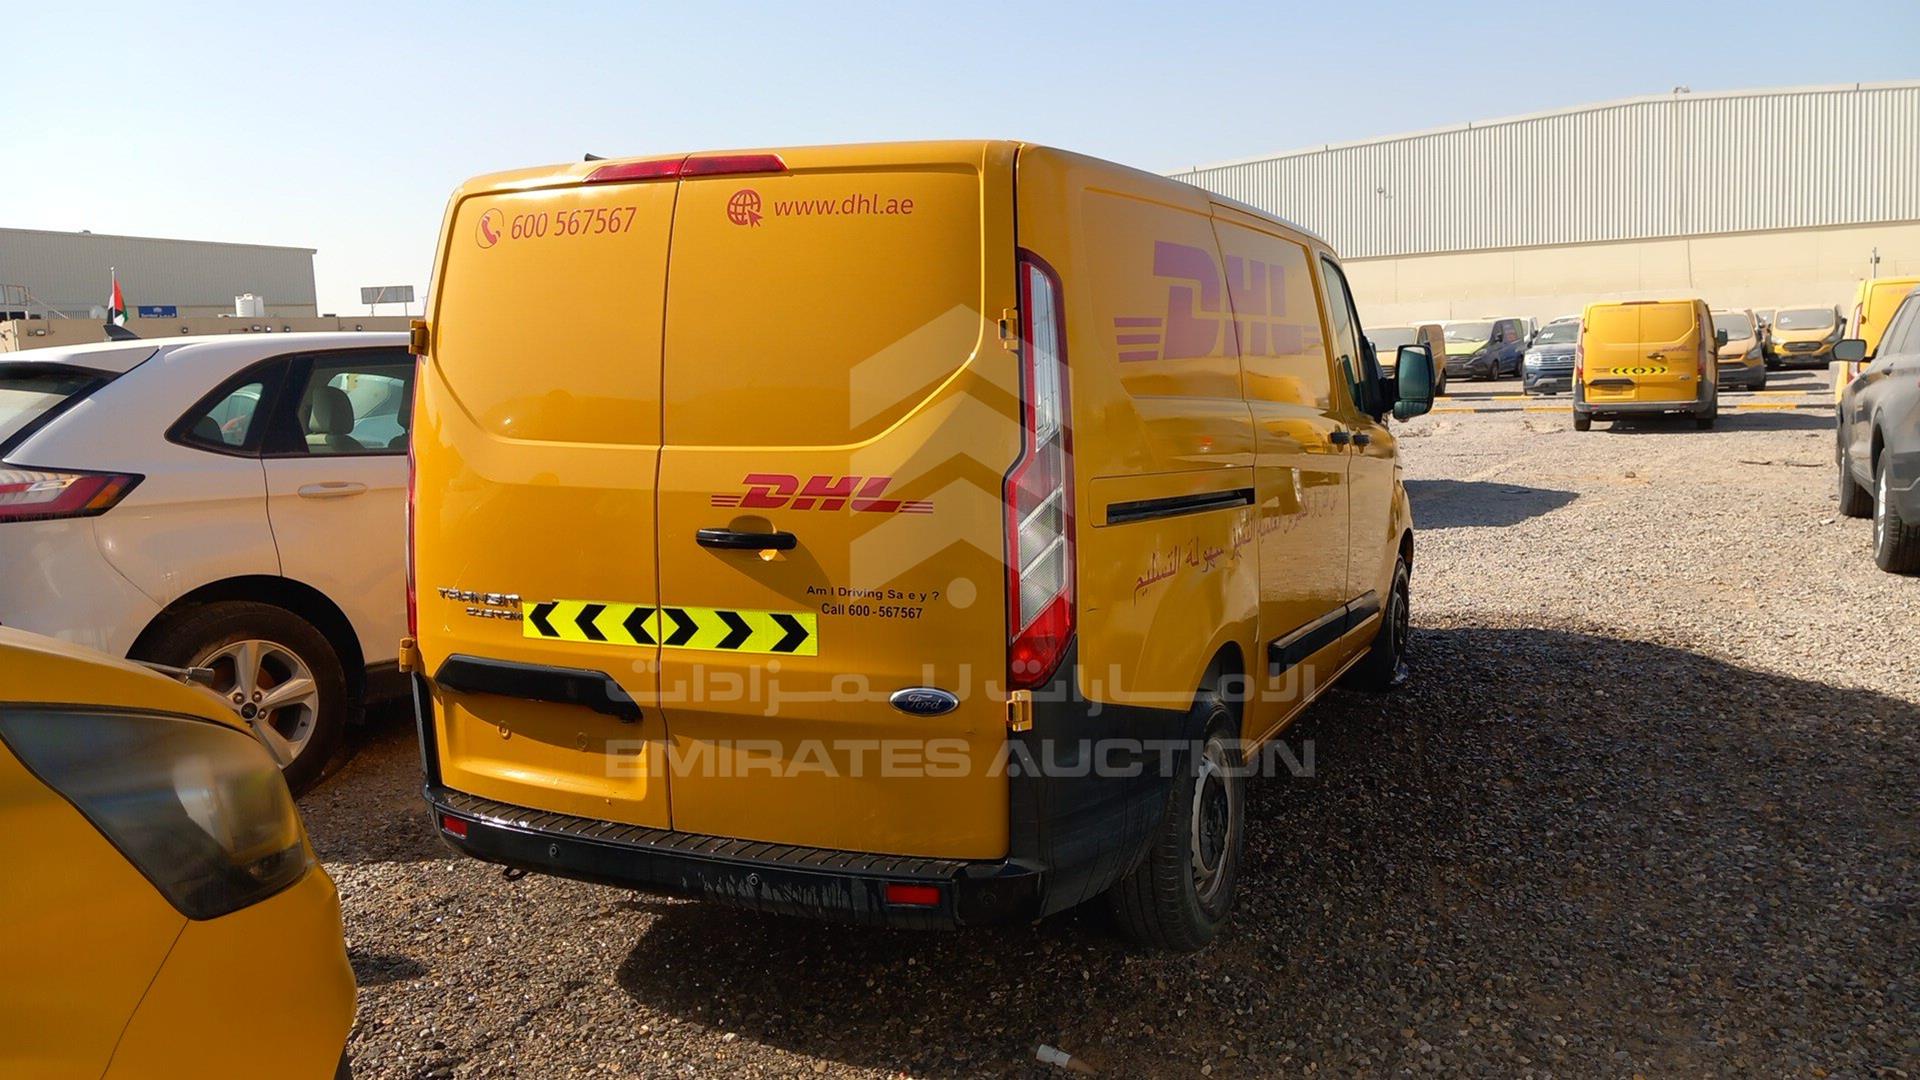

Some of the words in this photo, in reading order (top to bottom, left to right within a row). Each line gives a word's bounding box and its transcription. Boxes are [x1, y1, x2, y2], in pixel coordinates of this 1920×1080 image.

[774, 194, 913, 217] www.dhl.ae
[511, 213, 548, 240] 600
[554, 207, 637, 236] 567567
[1153, 239, 1304, 361] DHL
[739, 473, 902, 513] DHL
[806, 585, 827, 595] Am
[838, 587, 883, 601] Driving
[821, 603, 845, 615] Call
